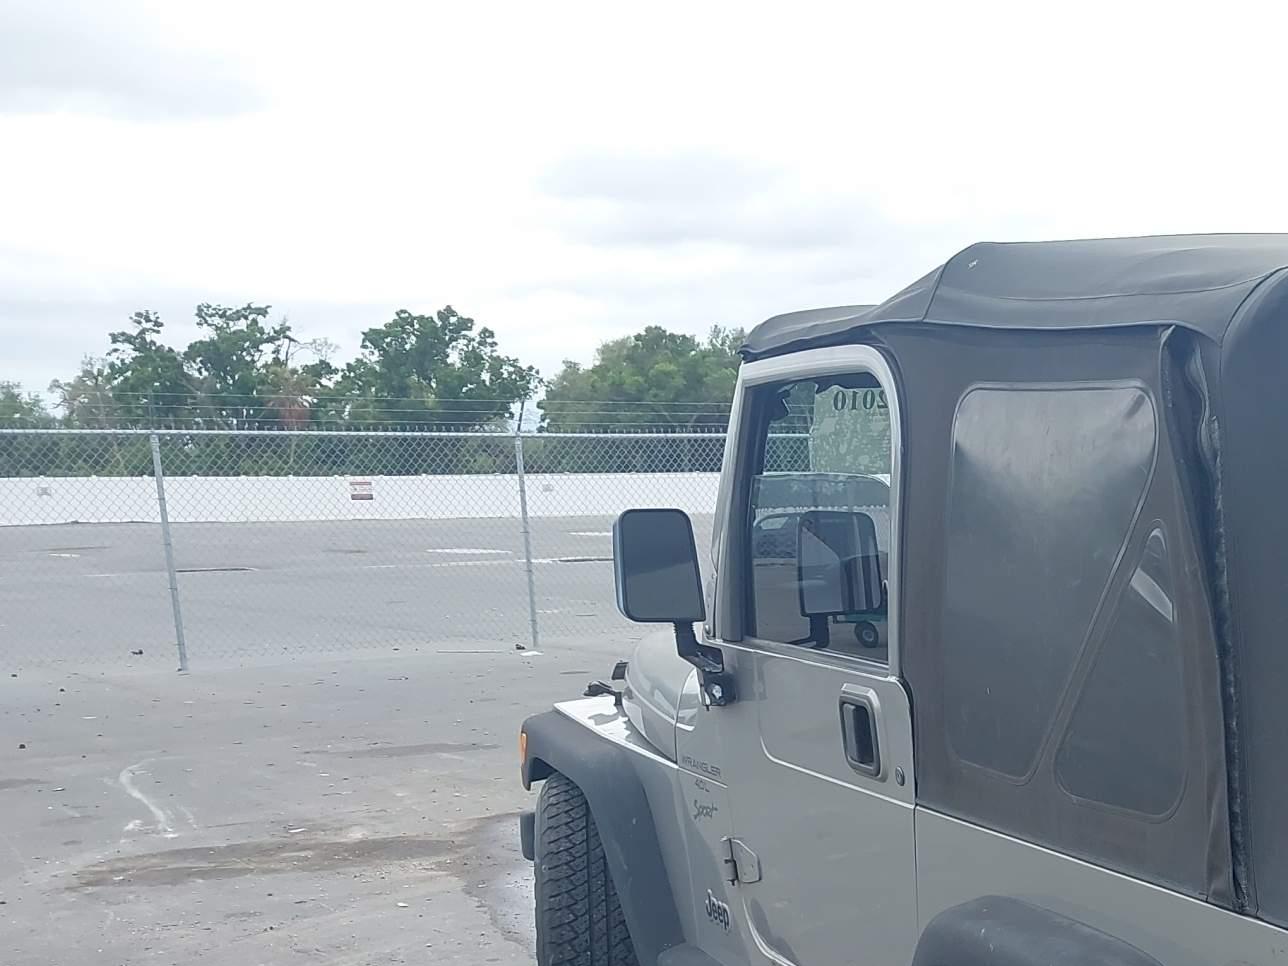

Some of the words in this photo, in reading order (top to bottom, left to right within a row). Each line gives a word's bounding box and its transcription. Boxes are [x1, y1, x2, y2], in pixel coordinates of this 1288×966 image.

[681, 756, 721, 778] WRANGLER
[693, 799, 718, 821] Sport
[705, 888, 730, 931] Jeep
